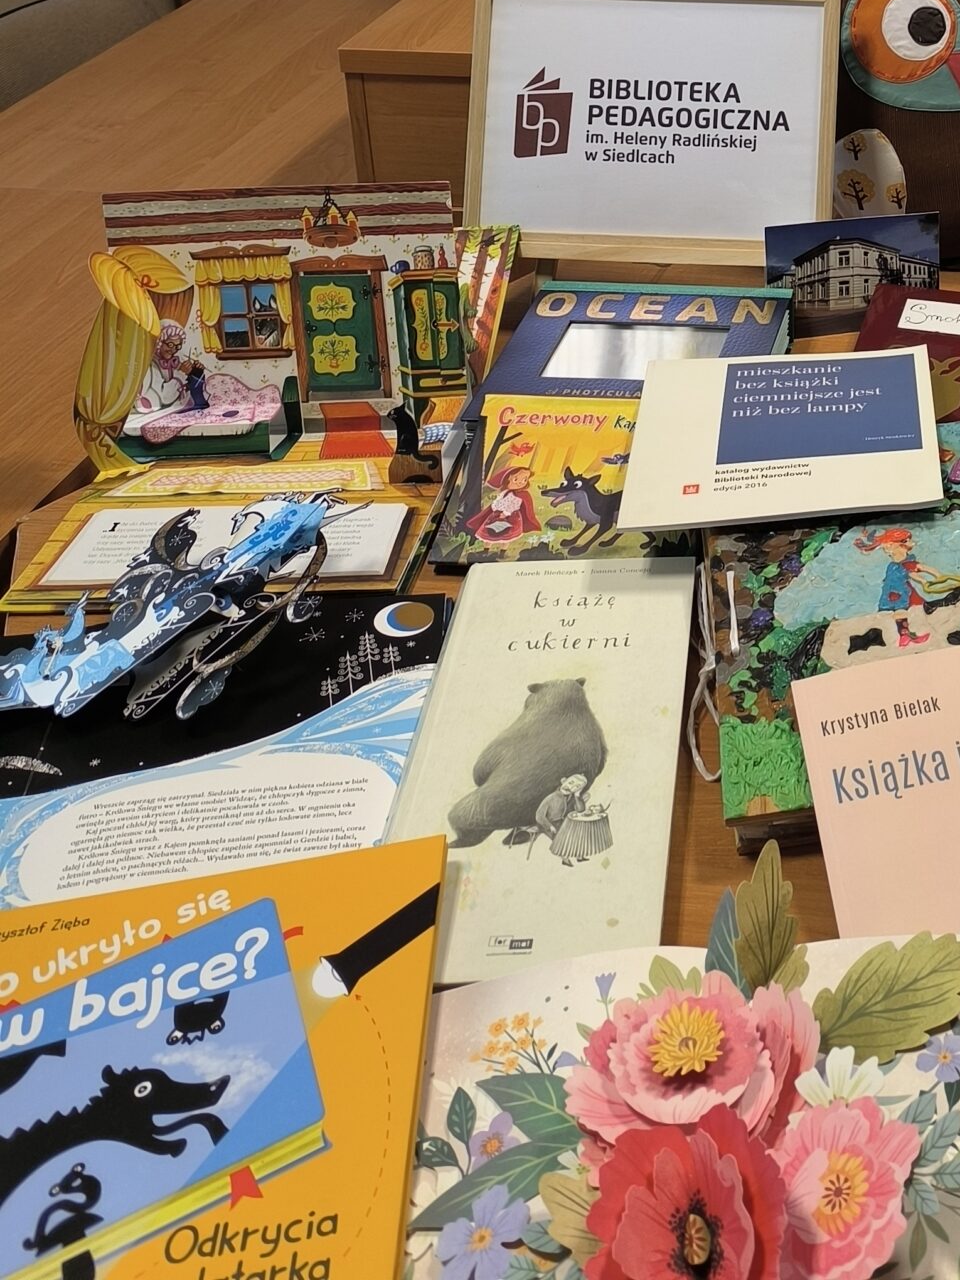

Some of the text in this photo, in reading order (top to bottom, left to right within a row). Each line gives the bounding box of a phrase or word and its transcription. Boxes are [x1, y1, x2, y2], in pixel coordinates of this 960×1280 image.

[589, 78, 741, 104] BIBLIOTEKA
[587, 105, 790, 132] PEDAGOGICZNA
[585, 130, 758, 153] im. Heleny Radlińskiej
[585, 149, 675, 164] w Siedlcach
[535, 292, 777, 326] OCEAN
[736, 363, 842, 377] mieszkanie
[562, 388, 641, 397] PHOTICULA
[735, 376, 839, 392] bez książki
[733, 387, 882, 406] ciemniejsze jest
[499, 406, 607, 431] Czerwony
[732, 400, 867, 418] niż bez lampy
[714, 470, 812, 484] Biblioteki Narodowej
[715, 463, 810, 476] katalog wydawnictw
[713, 484, 742, 493] edycja
[533, 590, 616, 610] książę
[560, 618, 576, 627] w
[508, 631, 631, 652] cukierni
[820, 696, 942, 737] Krystyna Bielak
[832, 749, 951, 804] Książka
[0, 917, 91, 943] ysztof Zięba
[0, 889, 232, 999] o ukryło się
[68, 926, 270, 1033] bajce?
[163, 1210, 339, 1264] Odkrycia
